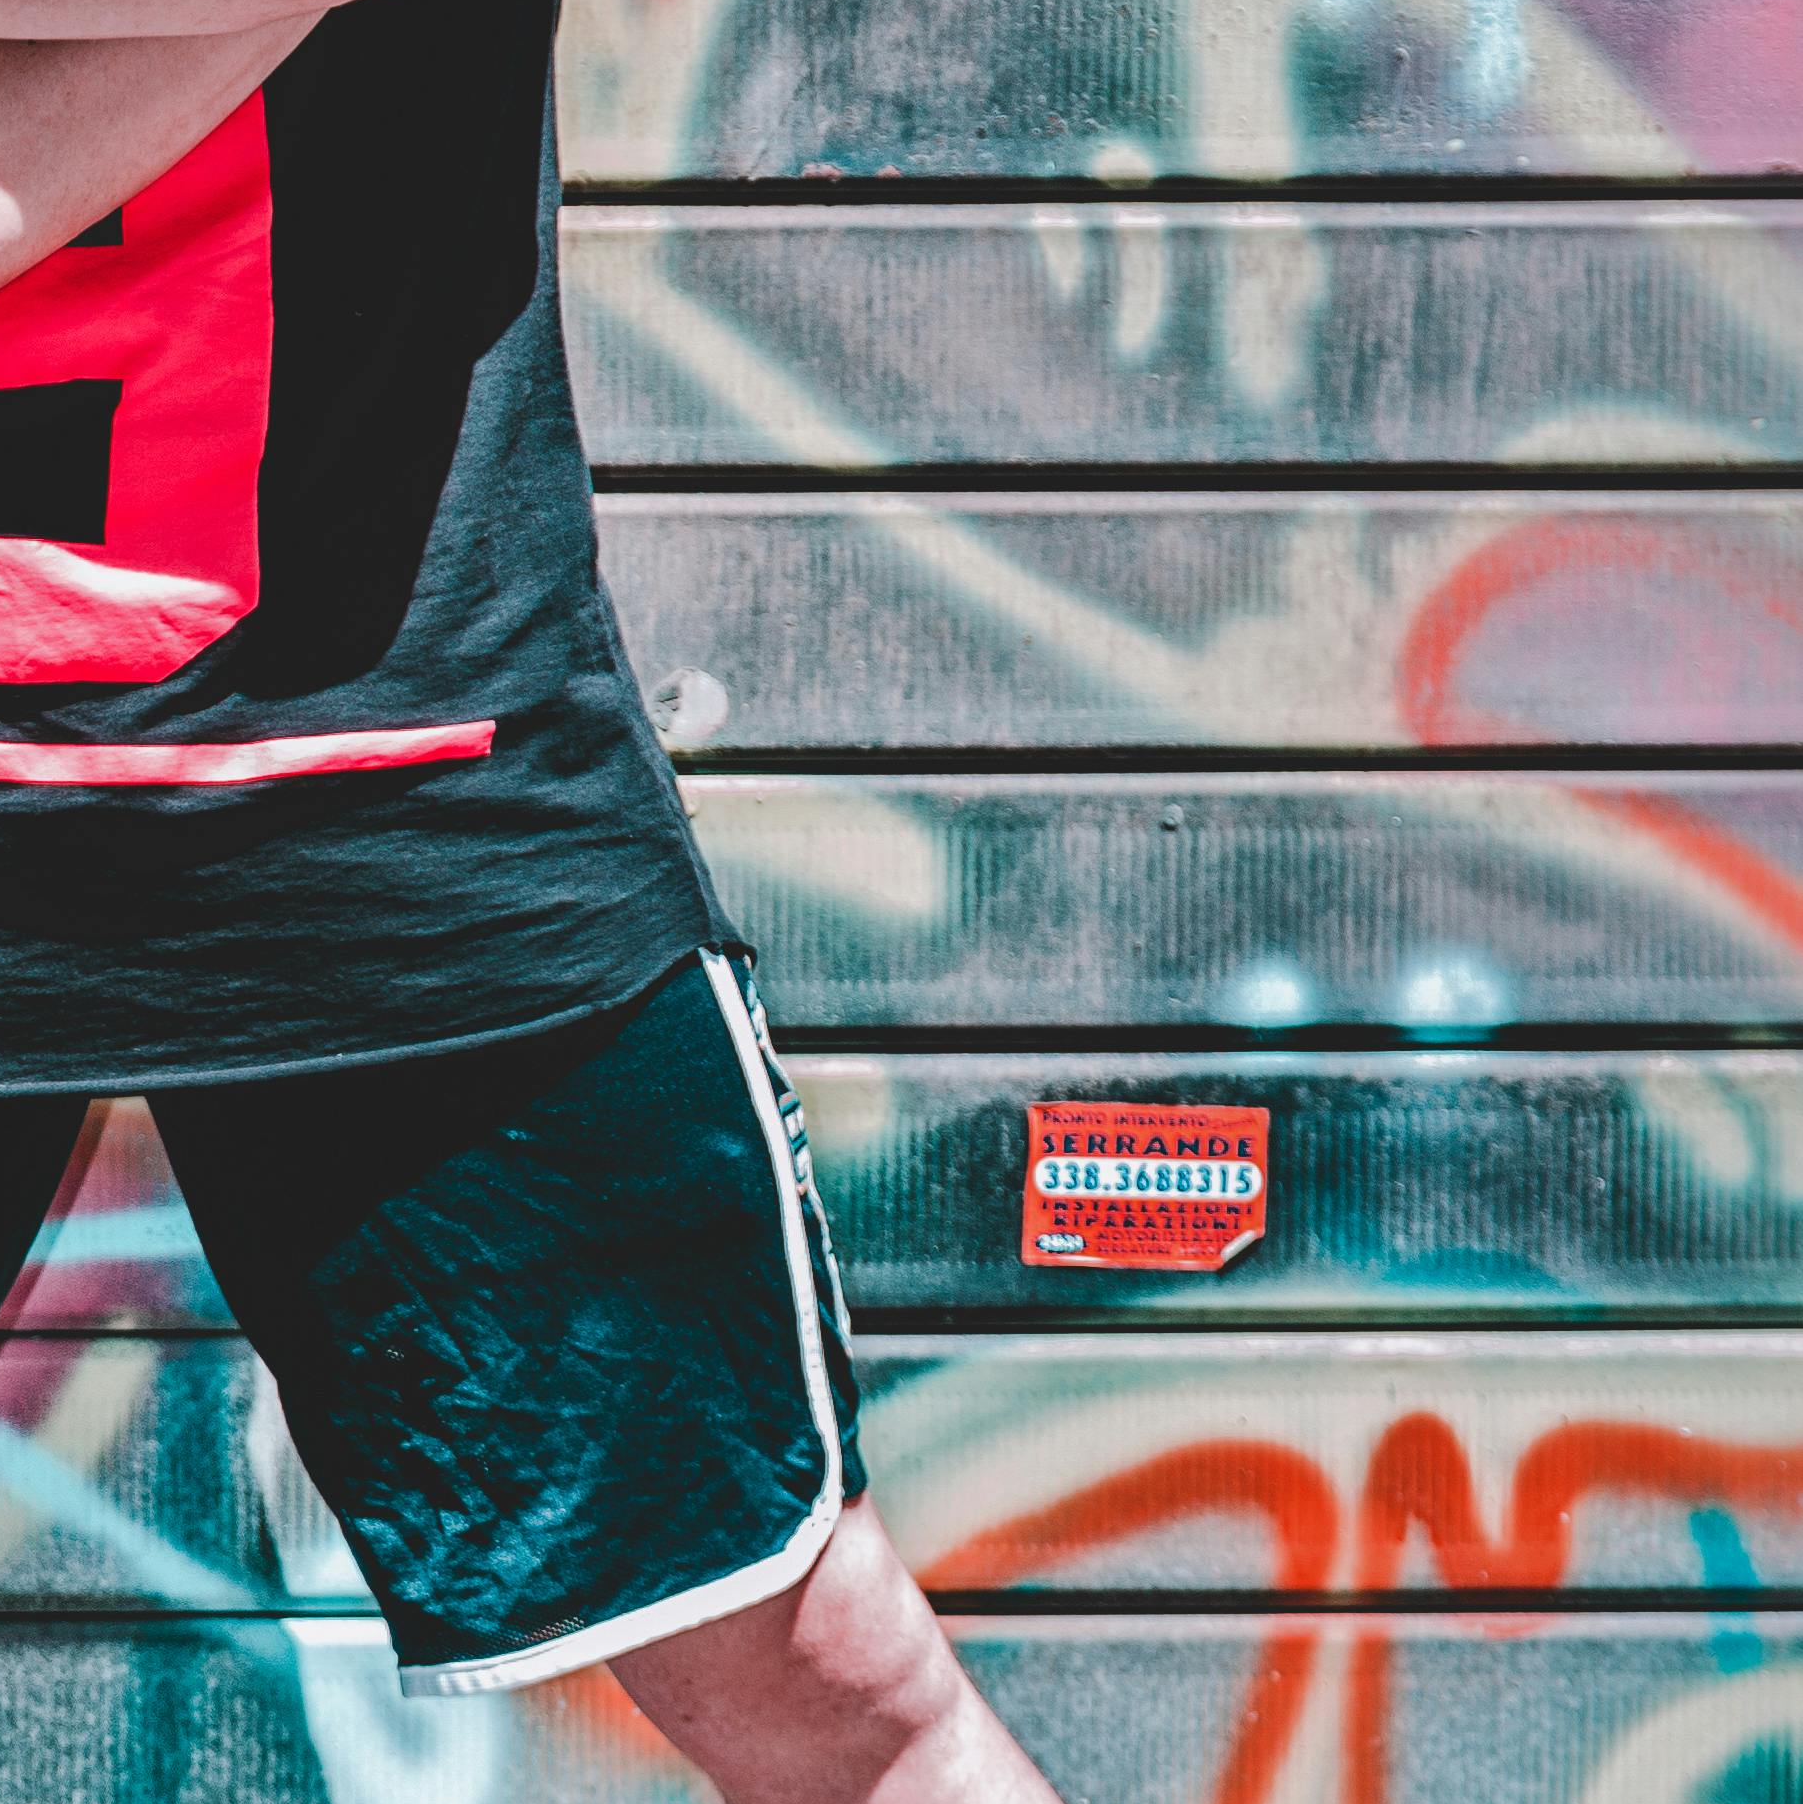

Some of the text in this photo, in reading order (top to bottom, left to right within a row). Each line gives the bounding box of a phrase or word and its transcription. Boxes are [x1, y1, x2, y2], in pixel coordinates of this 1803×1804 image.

[1043, 1132, 1253, 1158] SERRANDE
[1043, 1161, 1253, 1194] 338.3688315
[1042, 1200, 1253, 1214] INSTALLAZIONI
[1053, 1215, 1239, 1230] RIPARAZIONI
